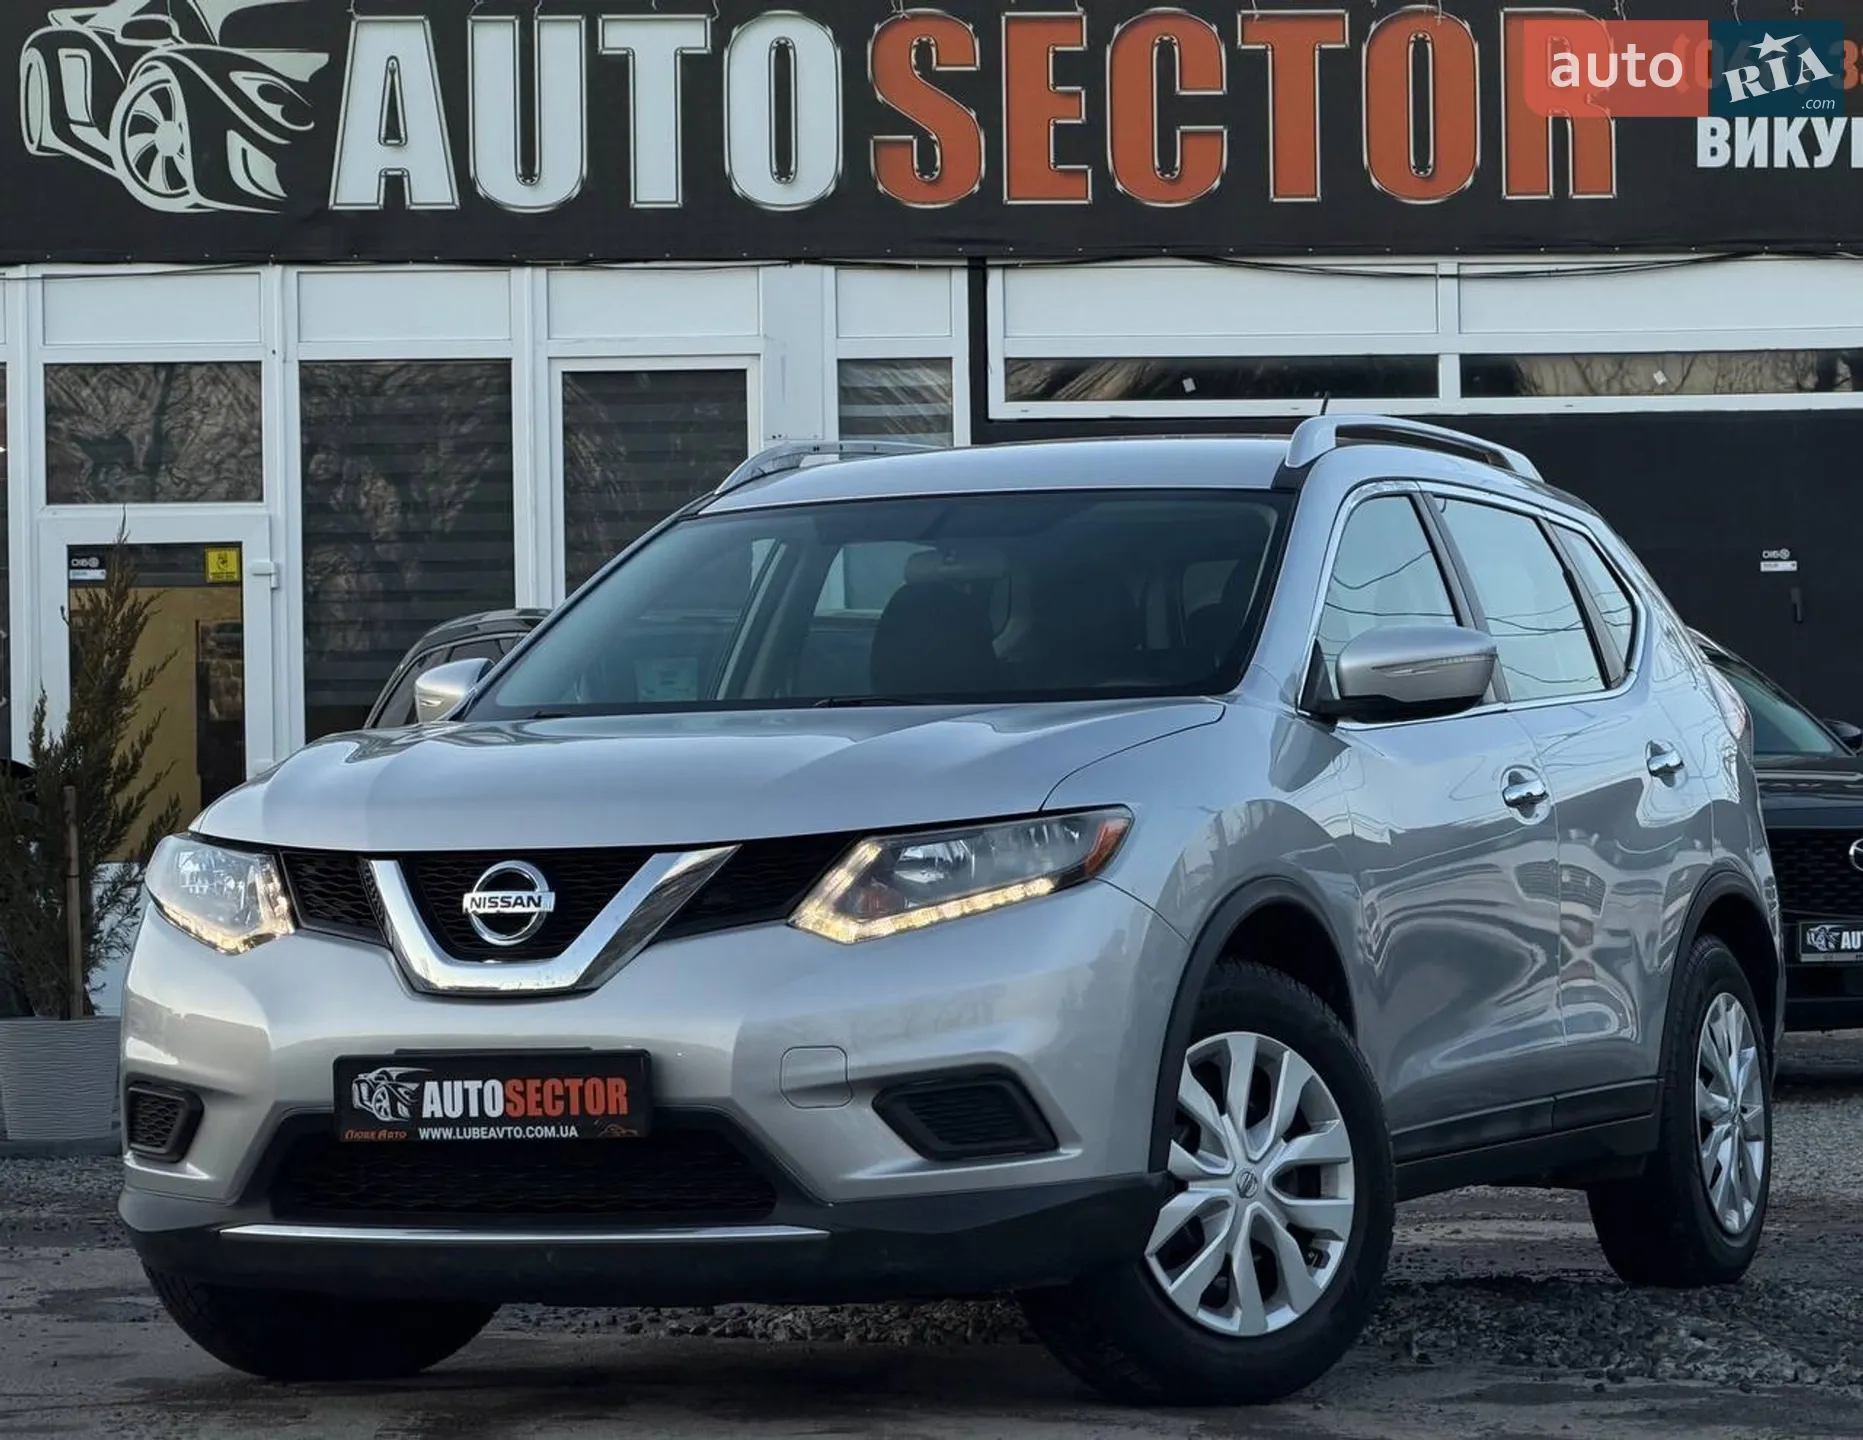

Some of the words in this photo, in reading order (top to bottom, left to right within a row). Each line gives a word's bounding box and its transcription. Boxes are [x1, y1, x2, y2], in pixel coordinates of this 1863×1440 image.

[470, 895, 542, 909] NISSAN
[1840, 930, 1863, 950] AU
[418, 1125, 579, 1140] WWW.LUBEAVTO.COM.UA
